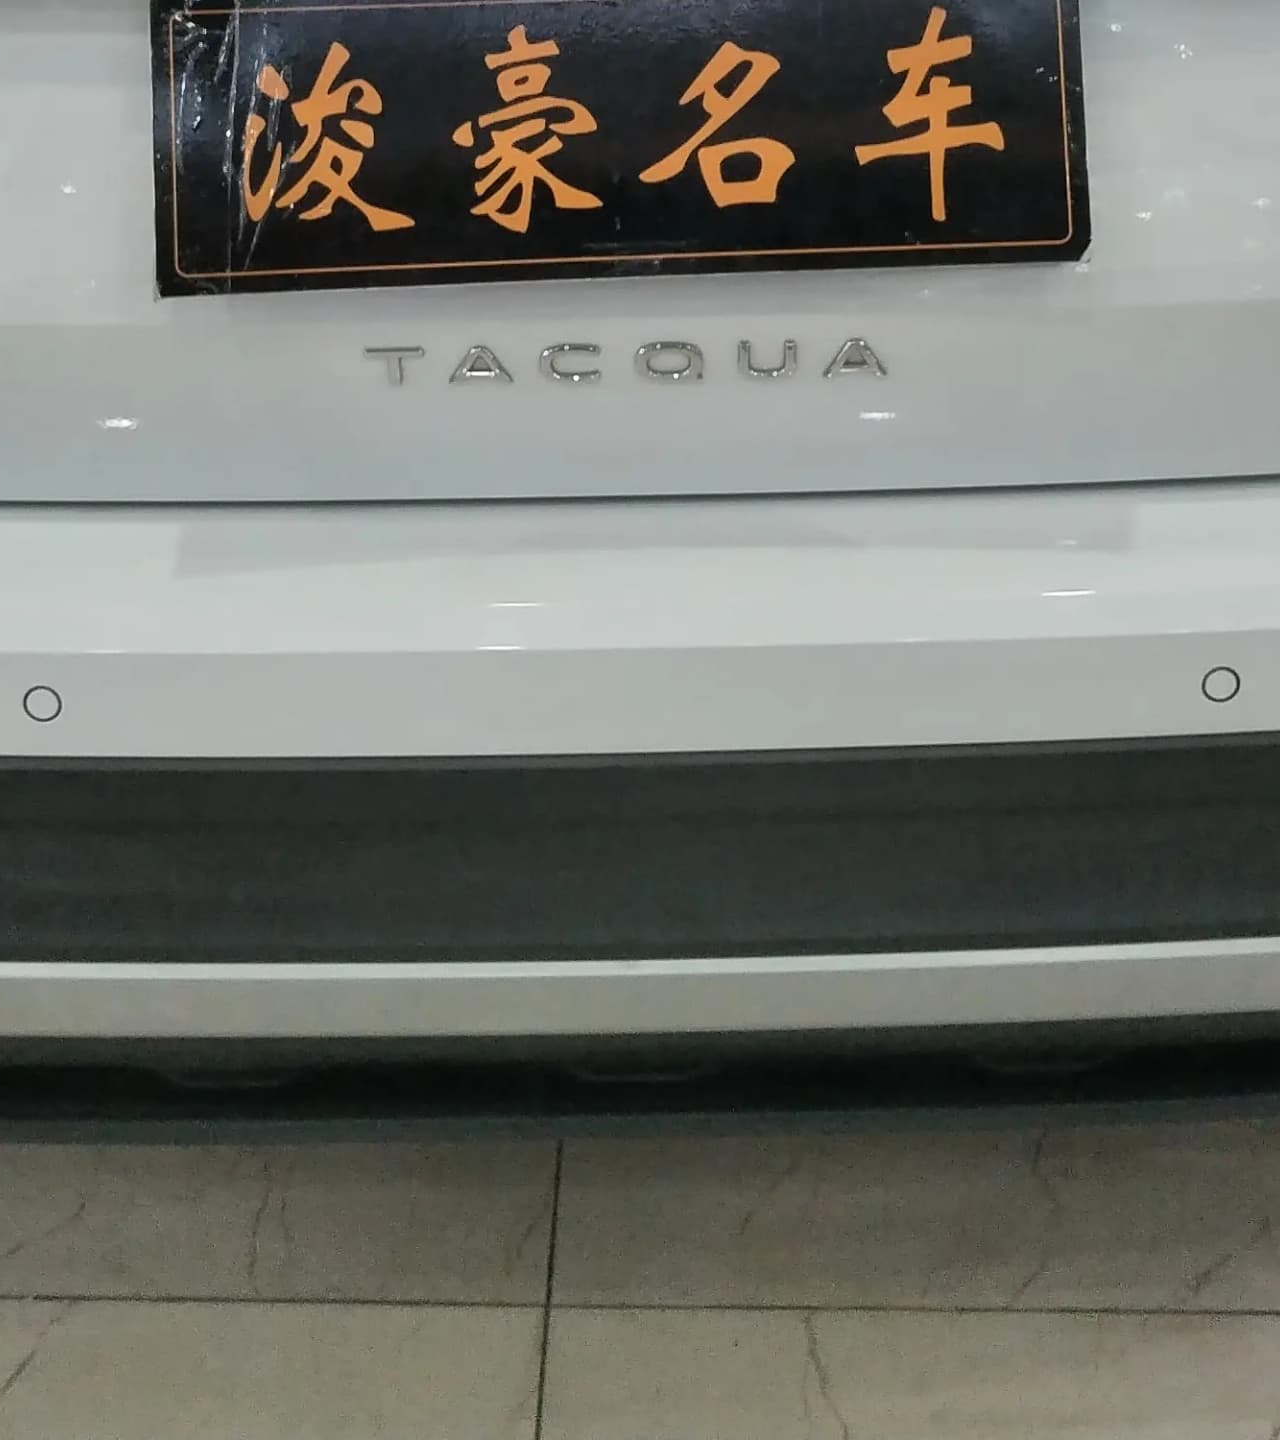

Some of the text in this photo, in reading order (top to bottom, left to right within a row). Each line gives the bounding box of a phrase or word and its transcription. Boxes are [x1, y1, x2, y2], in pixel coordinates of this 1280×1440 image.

[243, 6, 1004, 233] 浚豪名车
[363, 336, 891, 385] TACQUA
